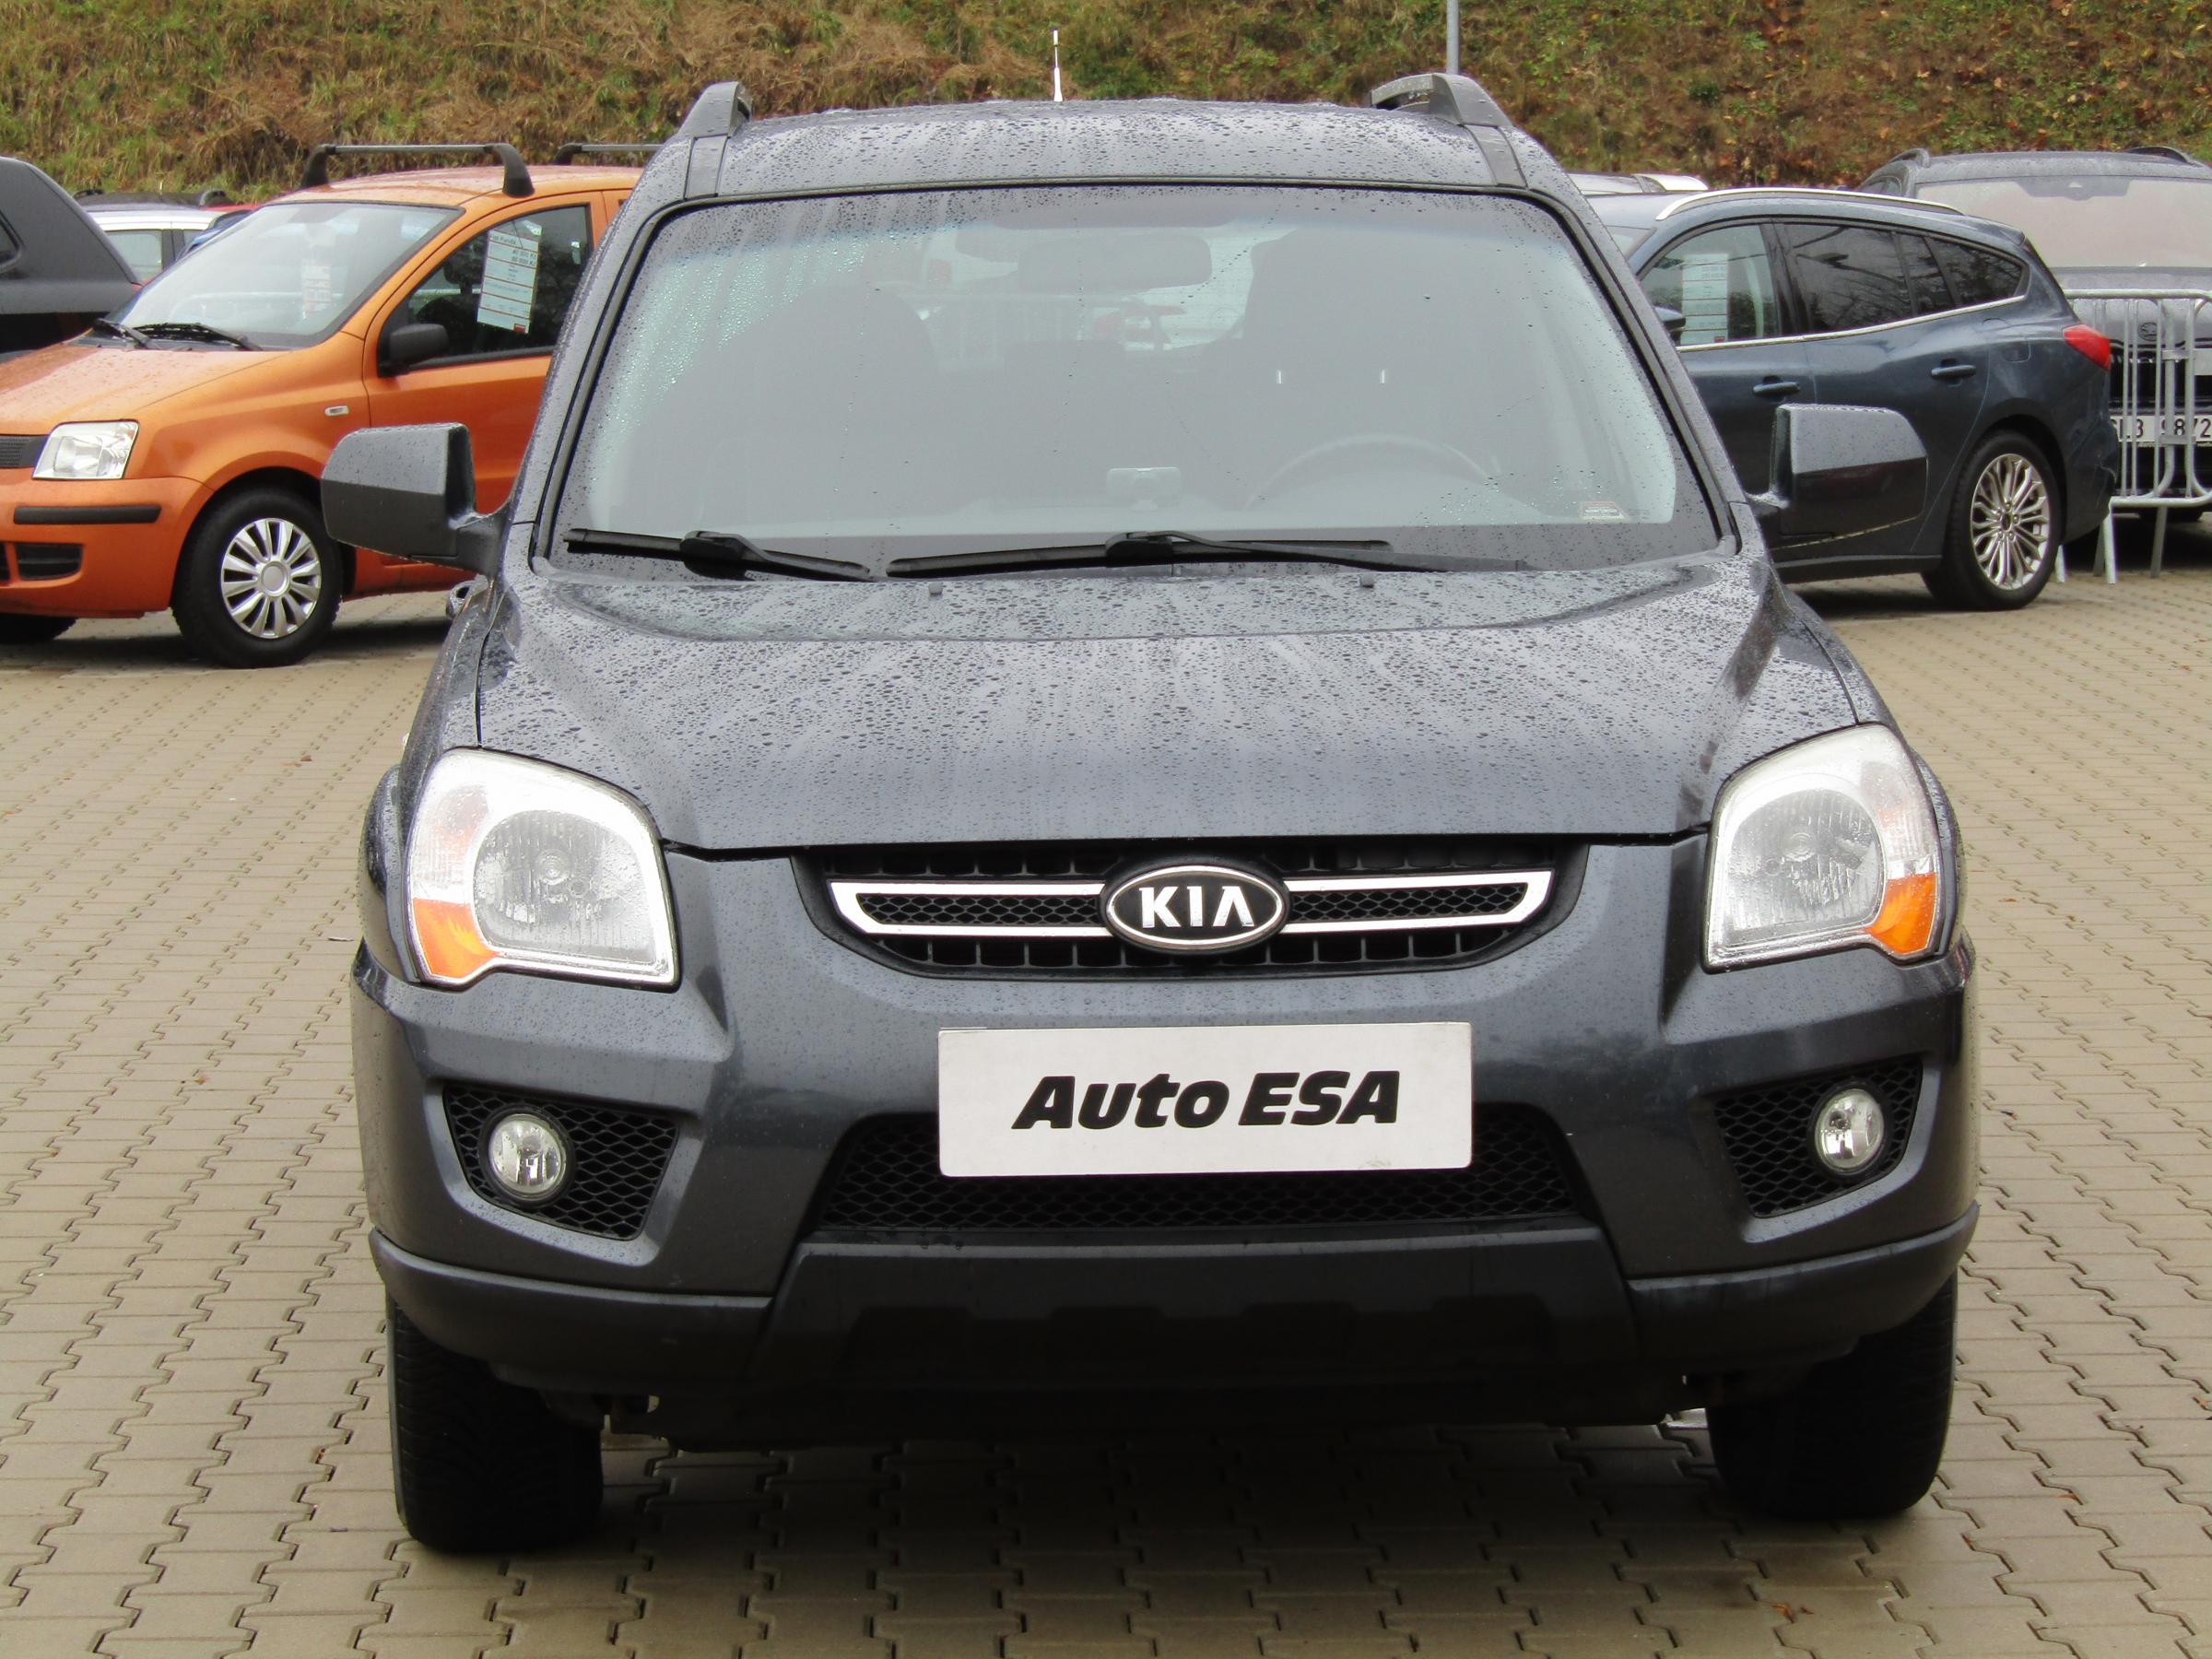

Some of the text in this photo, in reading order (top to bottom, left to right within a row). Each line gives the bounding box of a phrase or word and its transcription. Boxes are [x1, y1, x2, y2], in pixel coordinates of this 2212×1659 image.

[2110, 418, 2144, 439] L3
[1139, 886, 1254, 928] KIA
[1011, 1070, 1400, 1130] Auto ESA
